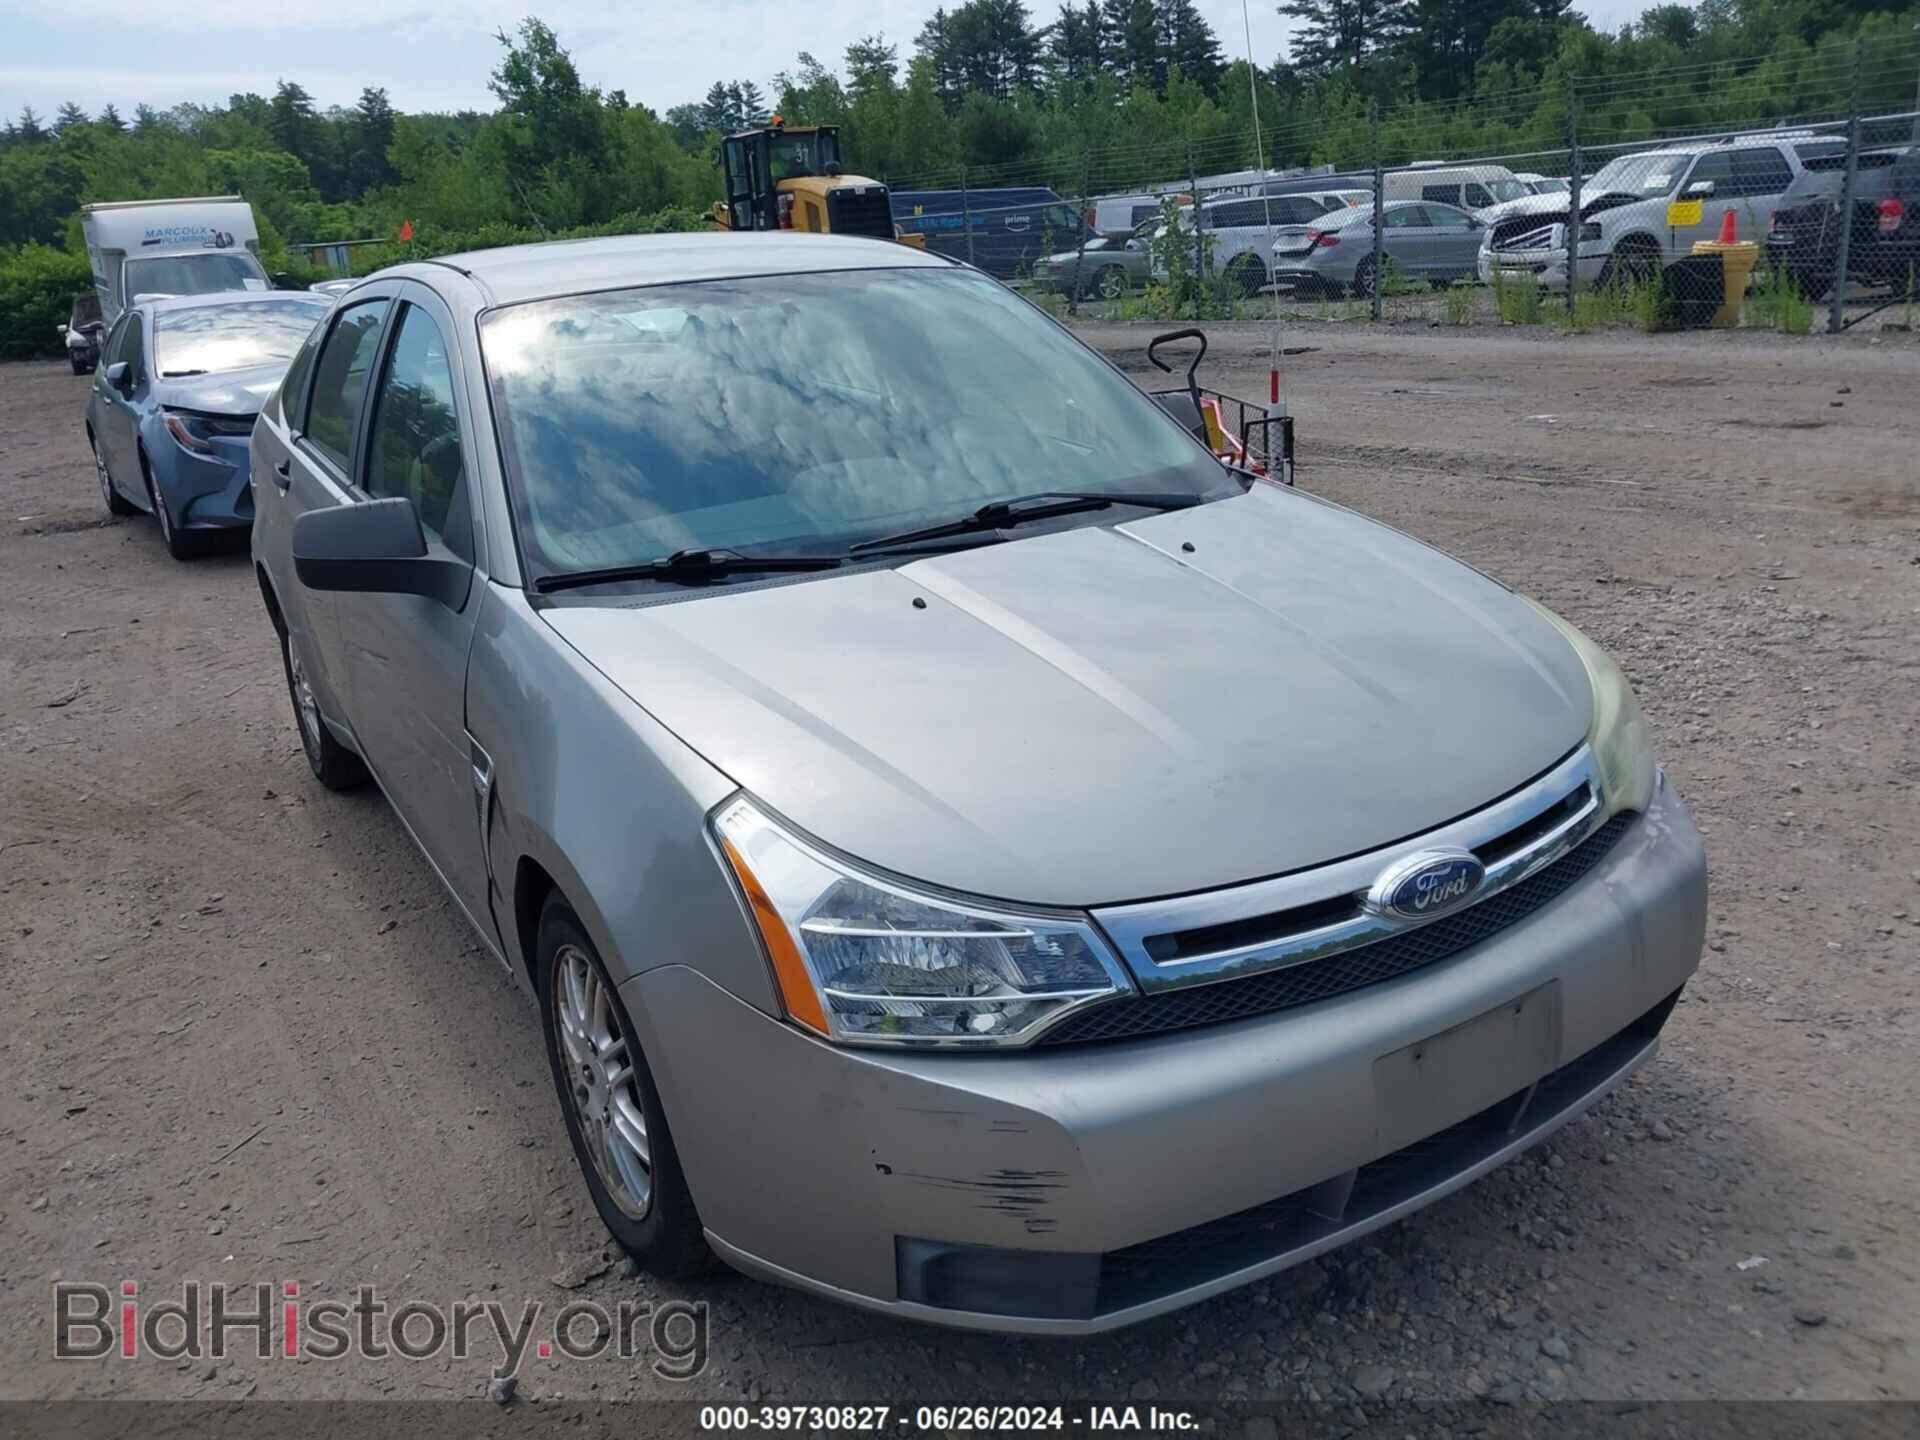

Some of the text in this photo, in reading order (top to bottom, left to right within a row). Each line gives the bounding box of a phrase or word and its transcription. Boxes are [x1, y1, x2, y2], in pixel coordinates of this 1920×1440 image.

[1004, 214, 1031, 225] prime
[144, 226, 208, 239] MARCOUX
[1415, 866, 1468, 909] Ford
